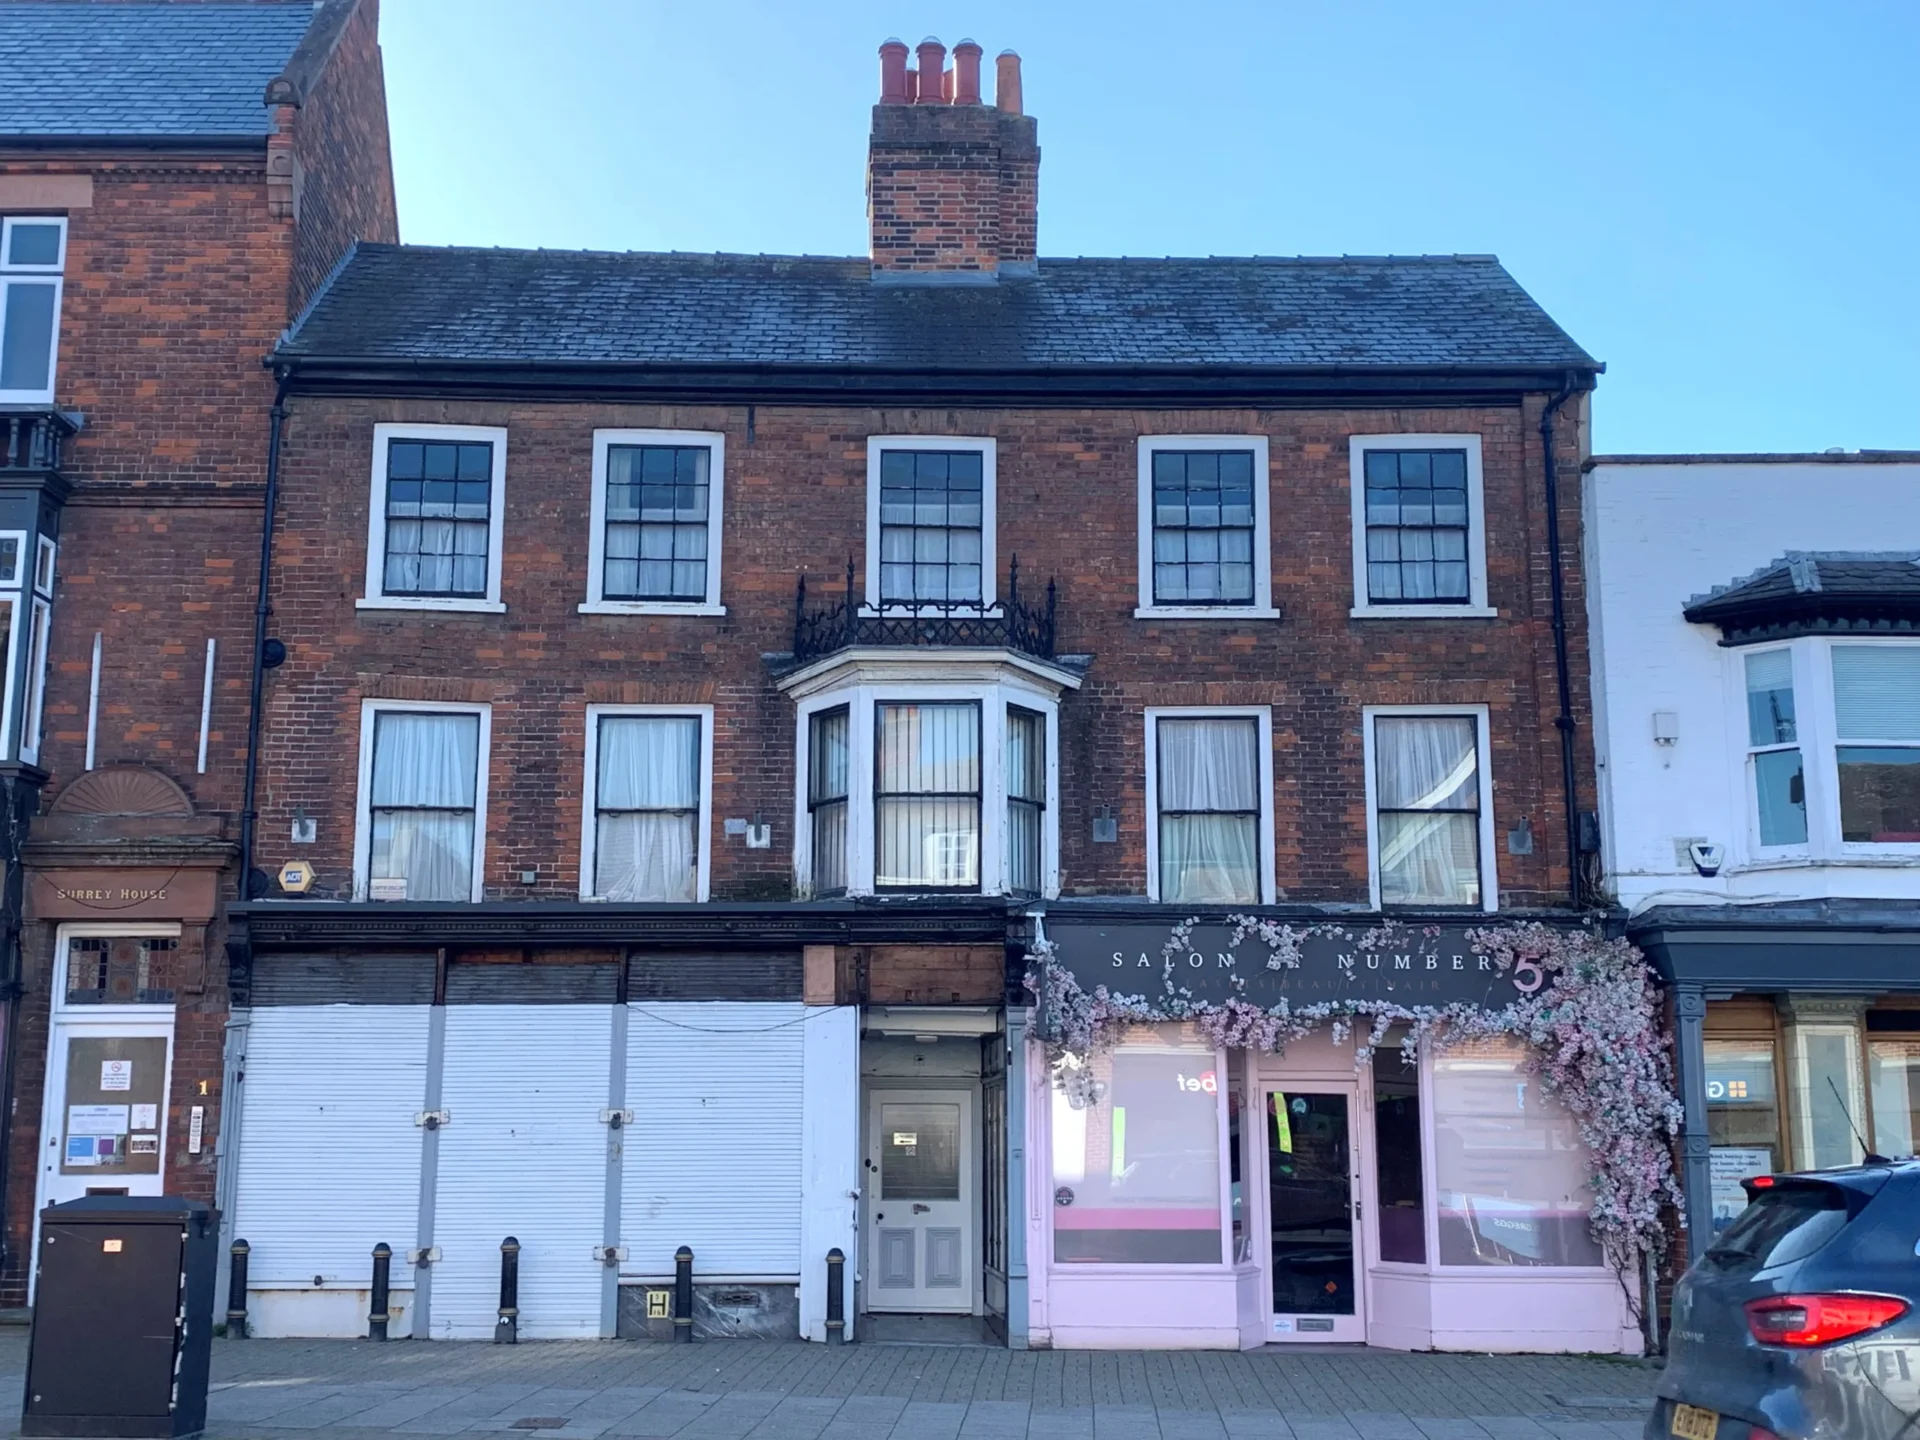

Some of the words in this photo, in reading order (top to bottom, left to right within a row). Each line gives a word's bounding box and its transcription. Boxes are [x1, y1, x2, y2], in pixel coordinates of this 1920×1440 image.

[286, 872, 303, 881] ADT
[57, 888, 112, 900] SURREY
[120, 888, 167, 900] HOUSE
[1112, 952, 1233, 968] SALON
[1337, 954, 1492, 970] NUMBER
[1511, 954, 1544, 992] 5
[199, 1080, 208, 1096] 1
[650, 1294, 666, 1315] H
